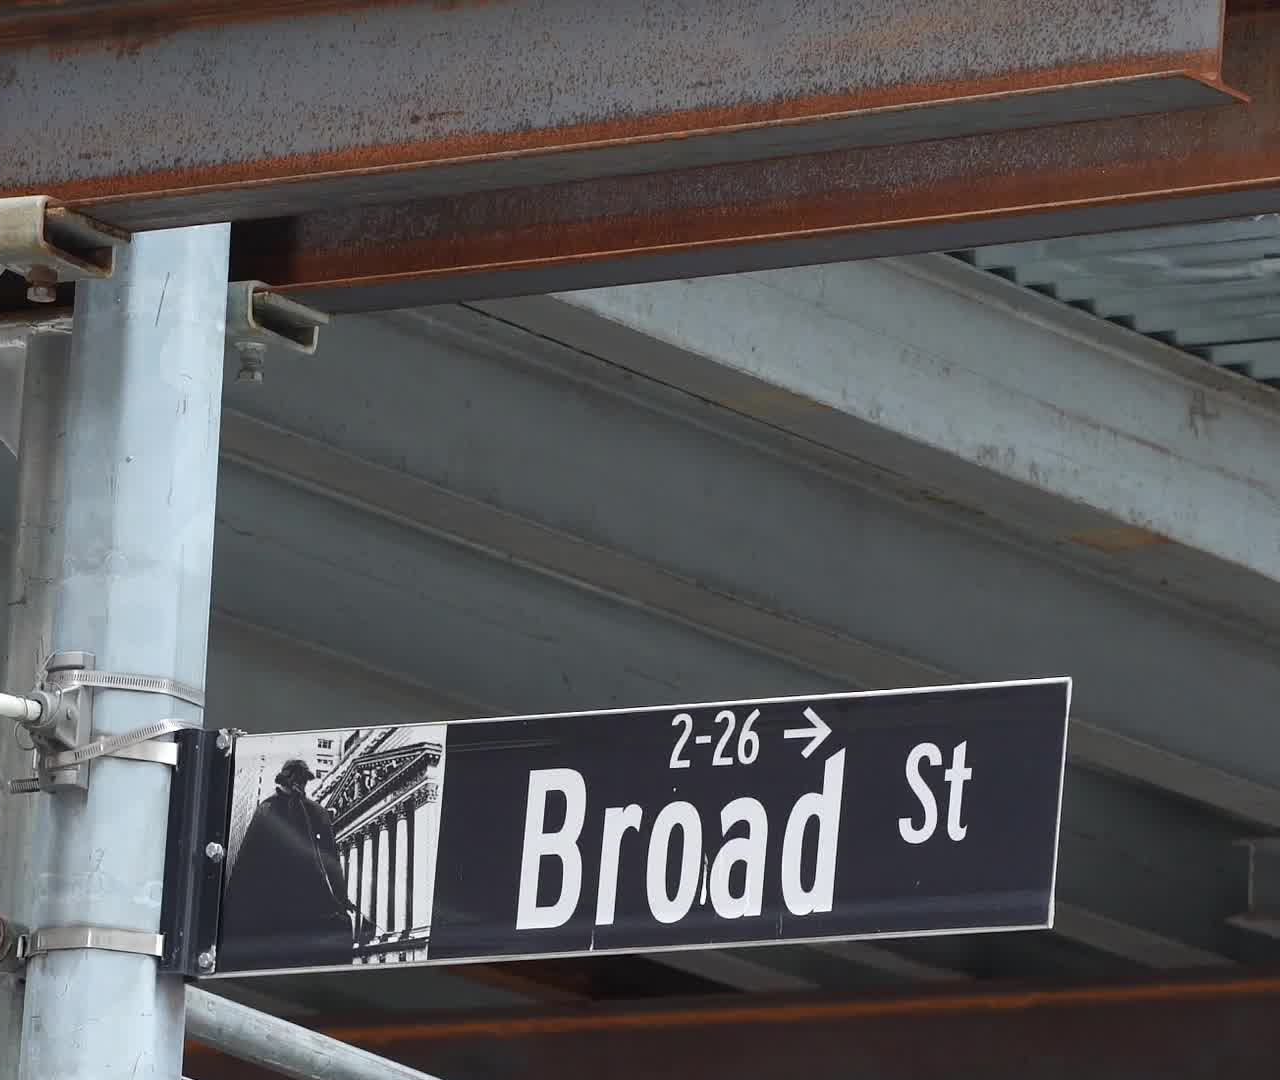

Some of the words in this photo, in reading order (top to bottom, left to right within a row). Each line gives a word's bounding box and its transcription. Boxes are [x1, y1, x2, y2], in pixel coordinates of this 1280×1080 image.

[669, 710, 761, 769] 2-26
[515, 747, 846, 930] Broad
[898, 740, 973, 844] St
